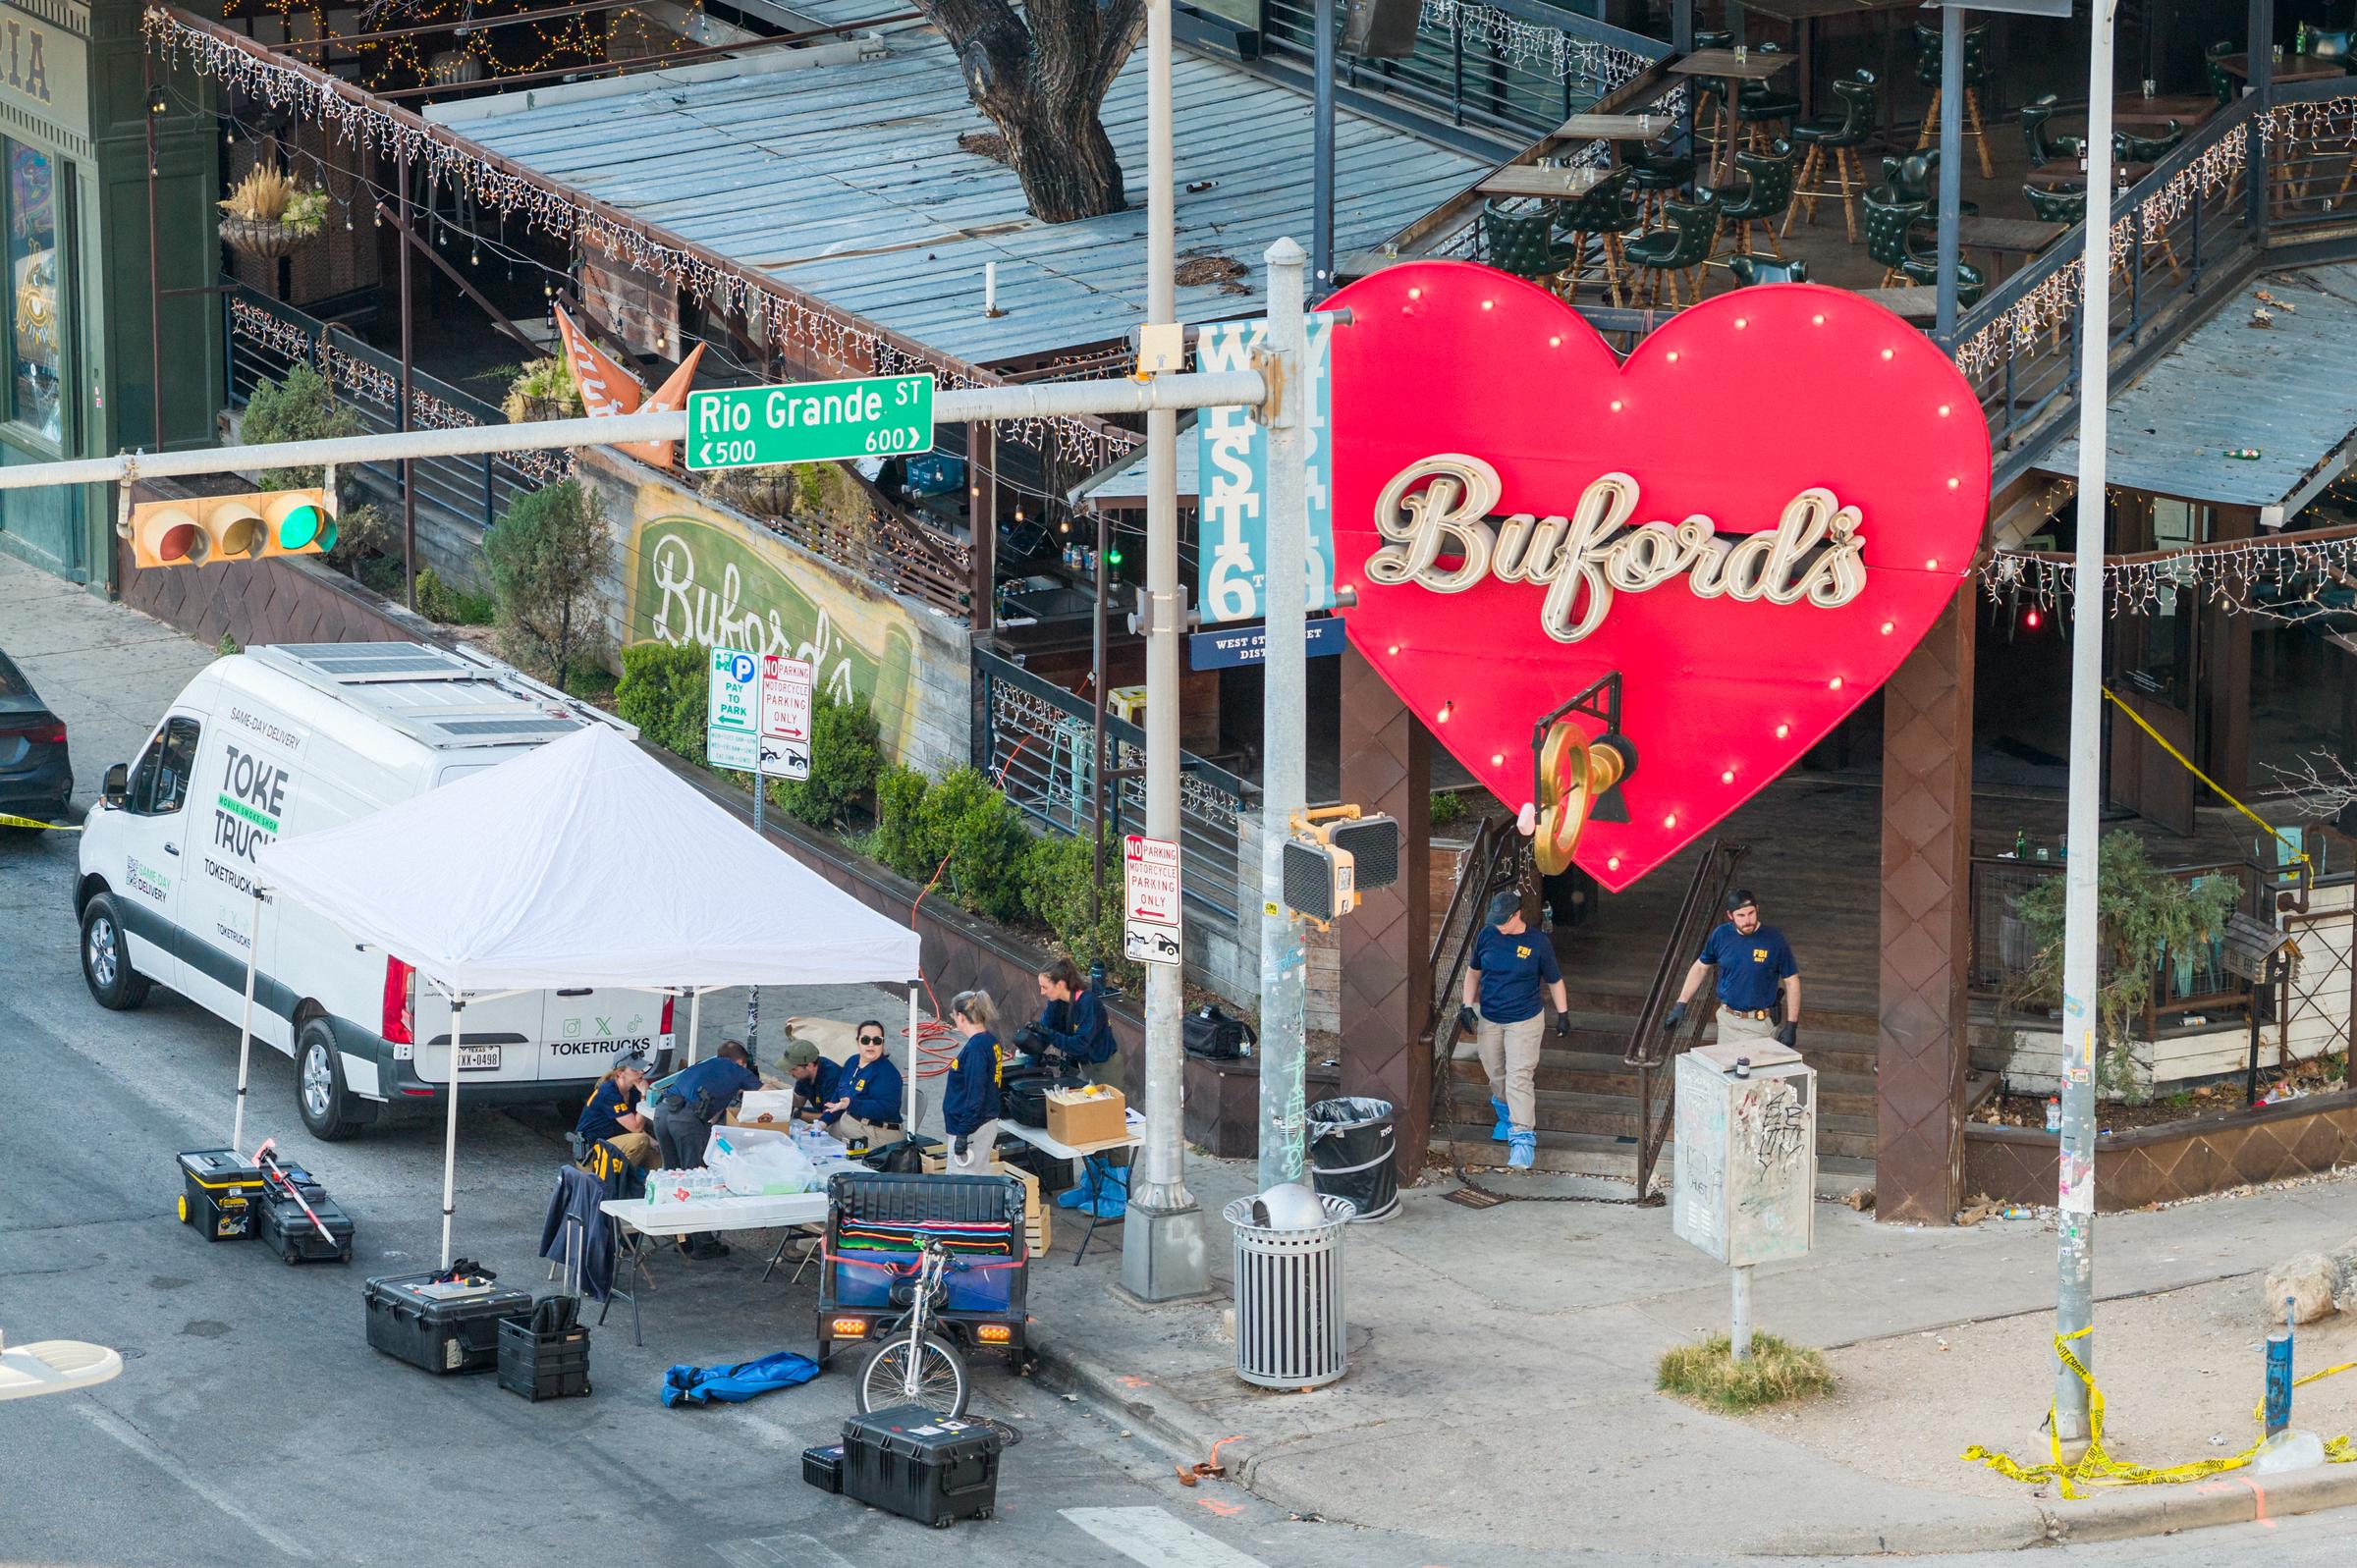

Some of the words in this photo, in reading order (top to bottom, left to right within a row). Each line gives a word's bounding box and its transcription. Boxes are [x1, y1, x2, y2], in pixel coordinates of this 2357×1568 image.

[0, 19, 51, 105] IA
[698, 394, 751, 434] Rio
[765, 385, 882, 429] Grande
[895, 380, 922, 406] ST
[865, 427, 904, 453] 600
[716, 440, 756, 463] 500
[1364, 453, 1867, 644] Buford's
[1216, 638, 1248, 650] WEST
[1251, 635, 1266, 645] 6T
[764, 659, 779, 677] NO
[779, 663, 809, 679] PARKING
[725, 681, 743, 693] PAY
[765, 680, 808, 697] MOTORCYCLE
[728, 693, 740, 704] TO
[766, 693, 806, 711] PARKING
[720, 703, 747, 717] PARK
[774, 711, 797, 725] ONLY
[230, 707, 268, 734] SAME-DAY
[266, 725, 301, 750] DELIVERY
[223, 744, 289, 818] TOKE
[214, 809, 277, 865] TRUC
[1127, 840, 1142, 857] NO
[1143, 844, 1177, 861] PARKING
[1130, 863, 1177, 879] MOTORCYCLE
[137, 878, 167, 903] DELIVERY
[1131, 876, 1175, 892] PARKING
[1140, 893, 1166, 907] ONLY
[1516, 946, 1532, 956] FBI
[1753, 948, 1768, 958] FBI
[550, 1037, 650, 1056] TOKETRUCKS
[614, 1103, 629, 1113] FB
